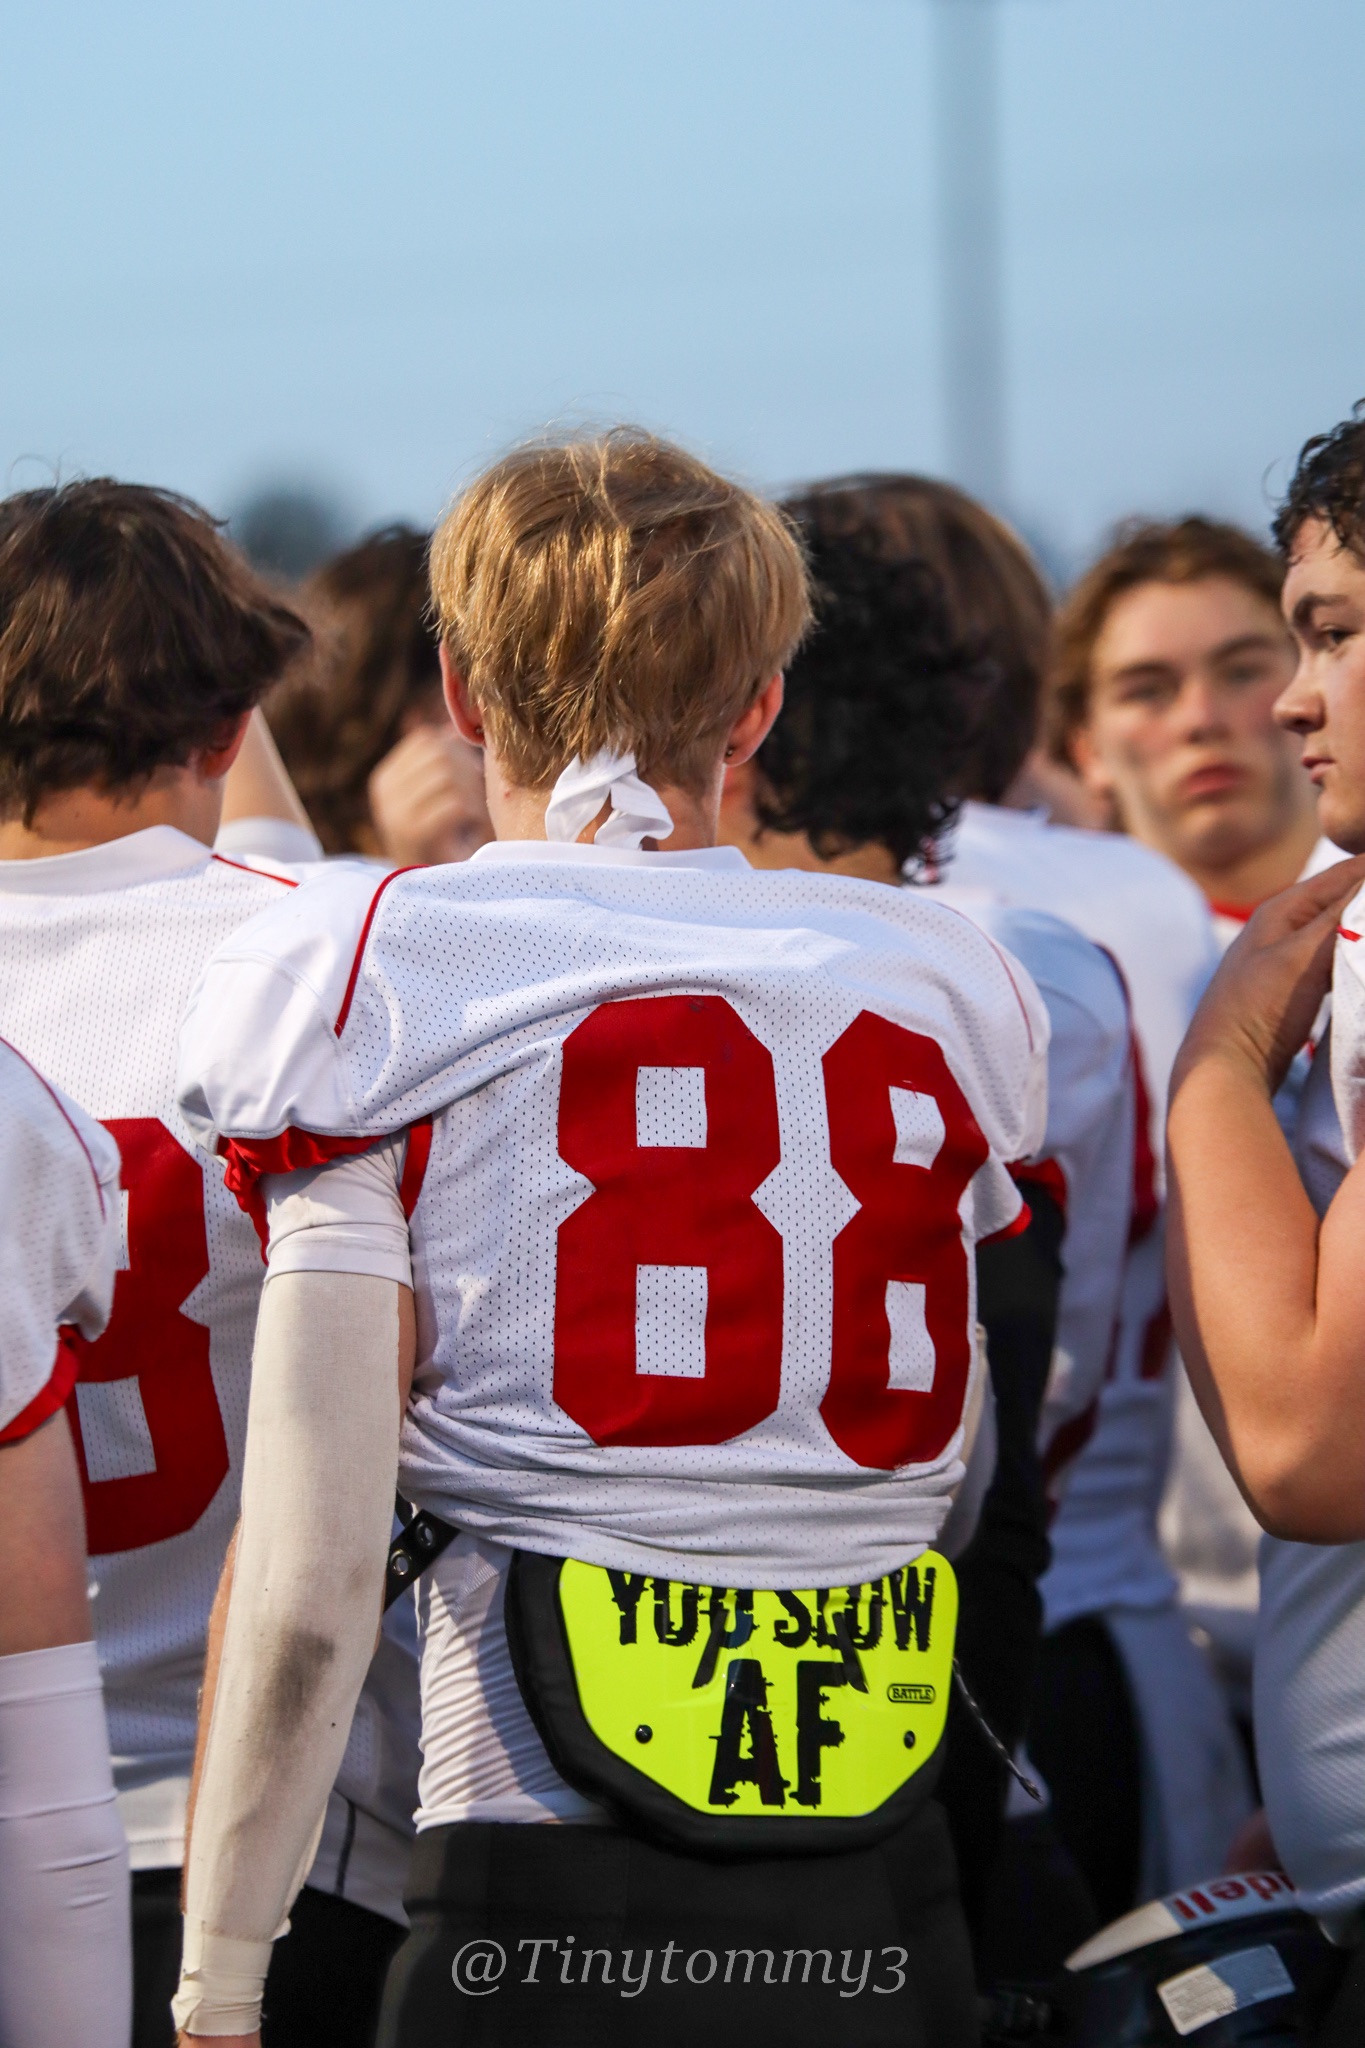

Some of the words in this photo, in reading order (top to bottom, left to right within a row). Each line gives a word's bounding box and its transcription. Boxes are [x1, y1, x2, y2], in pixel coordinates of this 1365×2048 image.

[553, 995, 989, 1470] 88
[604, 1567, 757, 1649] YOU
[774, 1566, 936, 1652] SLOW
[709, 1659, 845, 1808] AF
[892, 1687, 932, 1701] BATTLE
